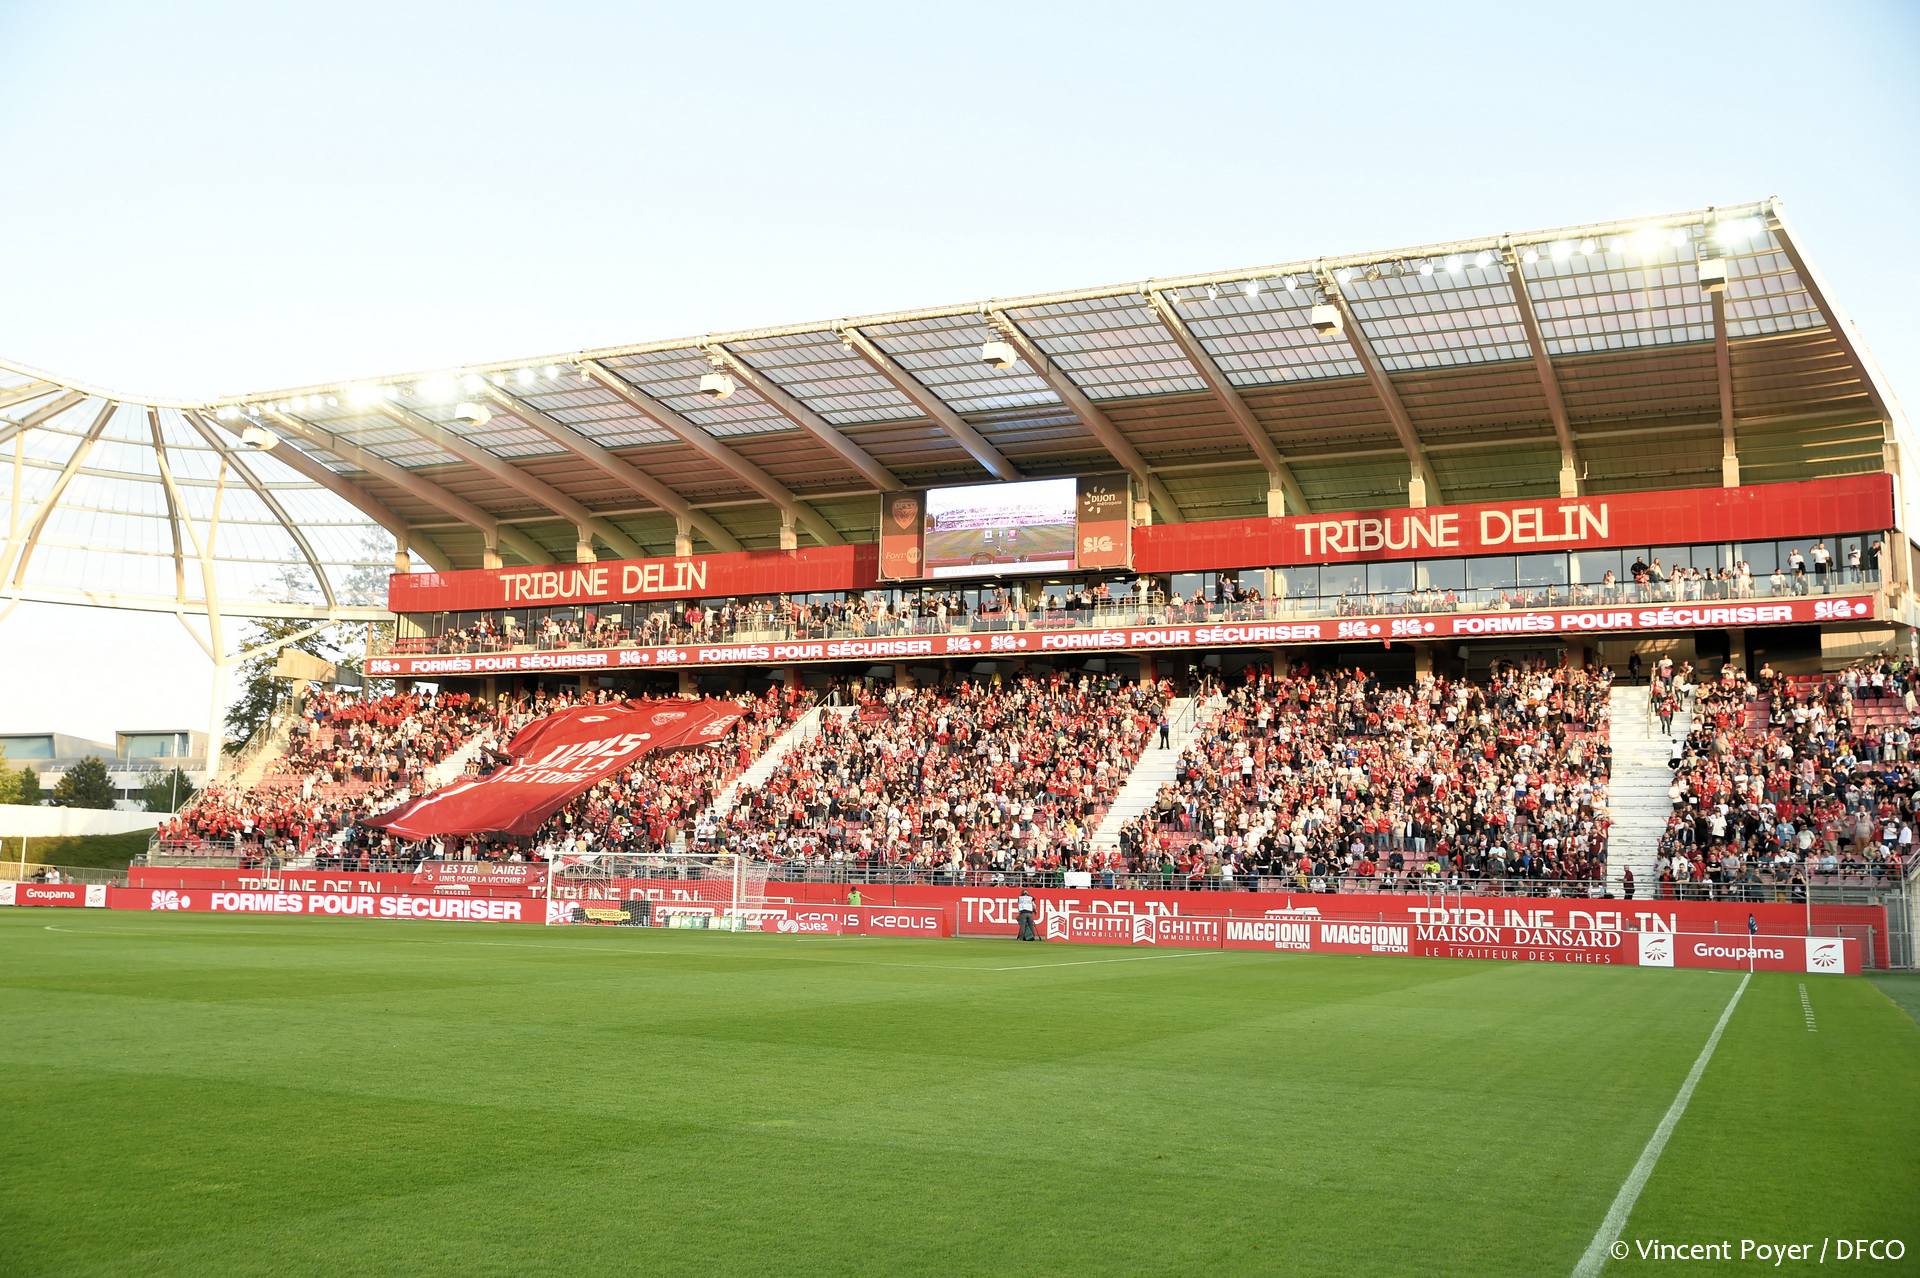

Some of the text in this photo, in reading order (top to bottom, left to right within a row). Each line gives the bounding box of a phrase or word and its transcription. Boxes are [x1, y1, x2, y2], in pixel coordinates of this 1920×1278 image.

[1295, 503, 1608, 555] TRIBUNE DELIN
[1083, 535, 1113, 553] SIG
[499, 561, 707, 601] TRIBUNE DELIN
[1815, 601, 1851, 618] SIG
[1391, 619, 1422, 635] SIG
[1453, 605, 1792, 634] FORMÉS POUR SÉCURISER
[1041, 625, 1320, 649] FORMÉS POUR SÉCURISER
[1338, 621, 1368, 637] SIG
[699, 640, 932, 661] FORMÉS POUR SÉCURISER
[946, 637, 971, 651] SIG
[991, 635, 1015, 650] SIG
[411, 653, 607, 672] FORMÉS POUR SÉCURISER
[440, 864, 527, 875] LES TEMRAIRES
[488, 876, 520, 885] VICTOIRE
[26, 888, 75, 900] Groupama
[151, 890, 178, 910] SIG
[211, 891, 521, 920] FORMÉS POUR SÉCURISER
[1072, 917, 1130, 932] GHITTI
[1159, 920, 1218, 935] GHITTI
[1227, 921, 1310, 943] MAGGIONI
[1159, 934, 1218, 942] IMMOBILIER
[1321, 924, 1408, 946] MAGGIONI
[1416, 925, 1622, 948] MAISON DANSARD
[1425, 947, 1611, 964] LE TRAITEUR DES CHEFS
[1693, 942, 1784, 960] Groupama
